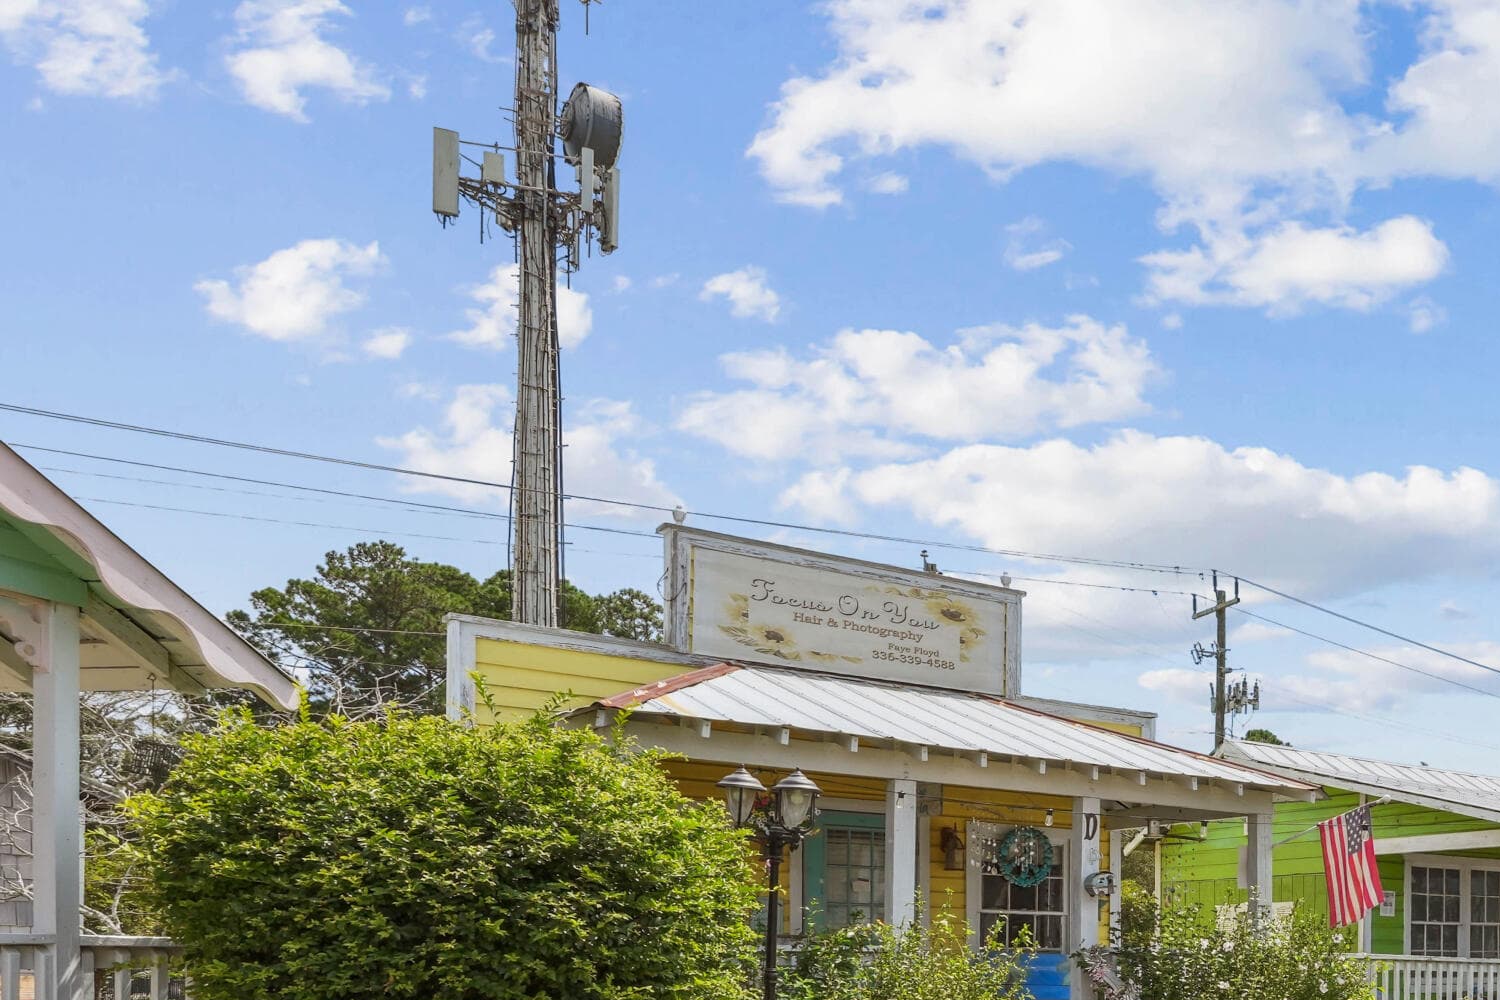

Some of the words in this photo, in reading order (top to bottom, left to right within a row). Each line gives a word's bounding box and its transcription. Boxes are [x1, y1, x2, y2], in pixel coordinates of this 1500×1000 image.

[751, 578, 833, 612] Focus
[838, 595, 880, 620] On
[883, 601, 940, 630] You
[792, 611, 823, 625] Hair
[827, 618, 839, 628] &
[842, 619, 924, 643] Photography
[872, 650, 956, 671] 336-339-4588
[888, 642, 911, 654] Faye
[914, 646, 940, 658] Floyd
[1084, 812, 1098, 840] D
